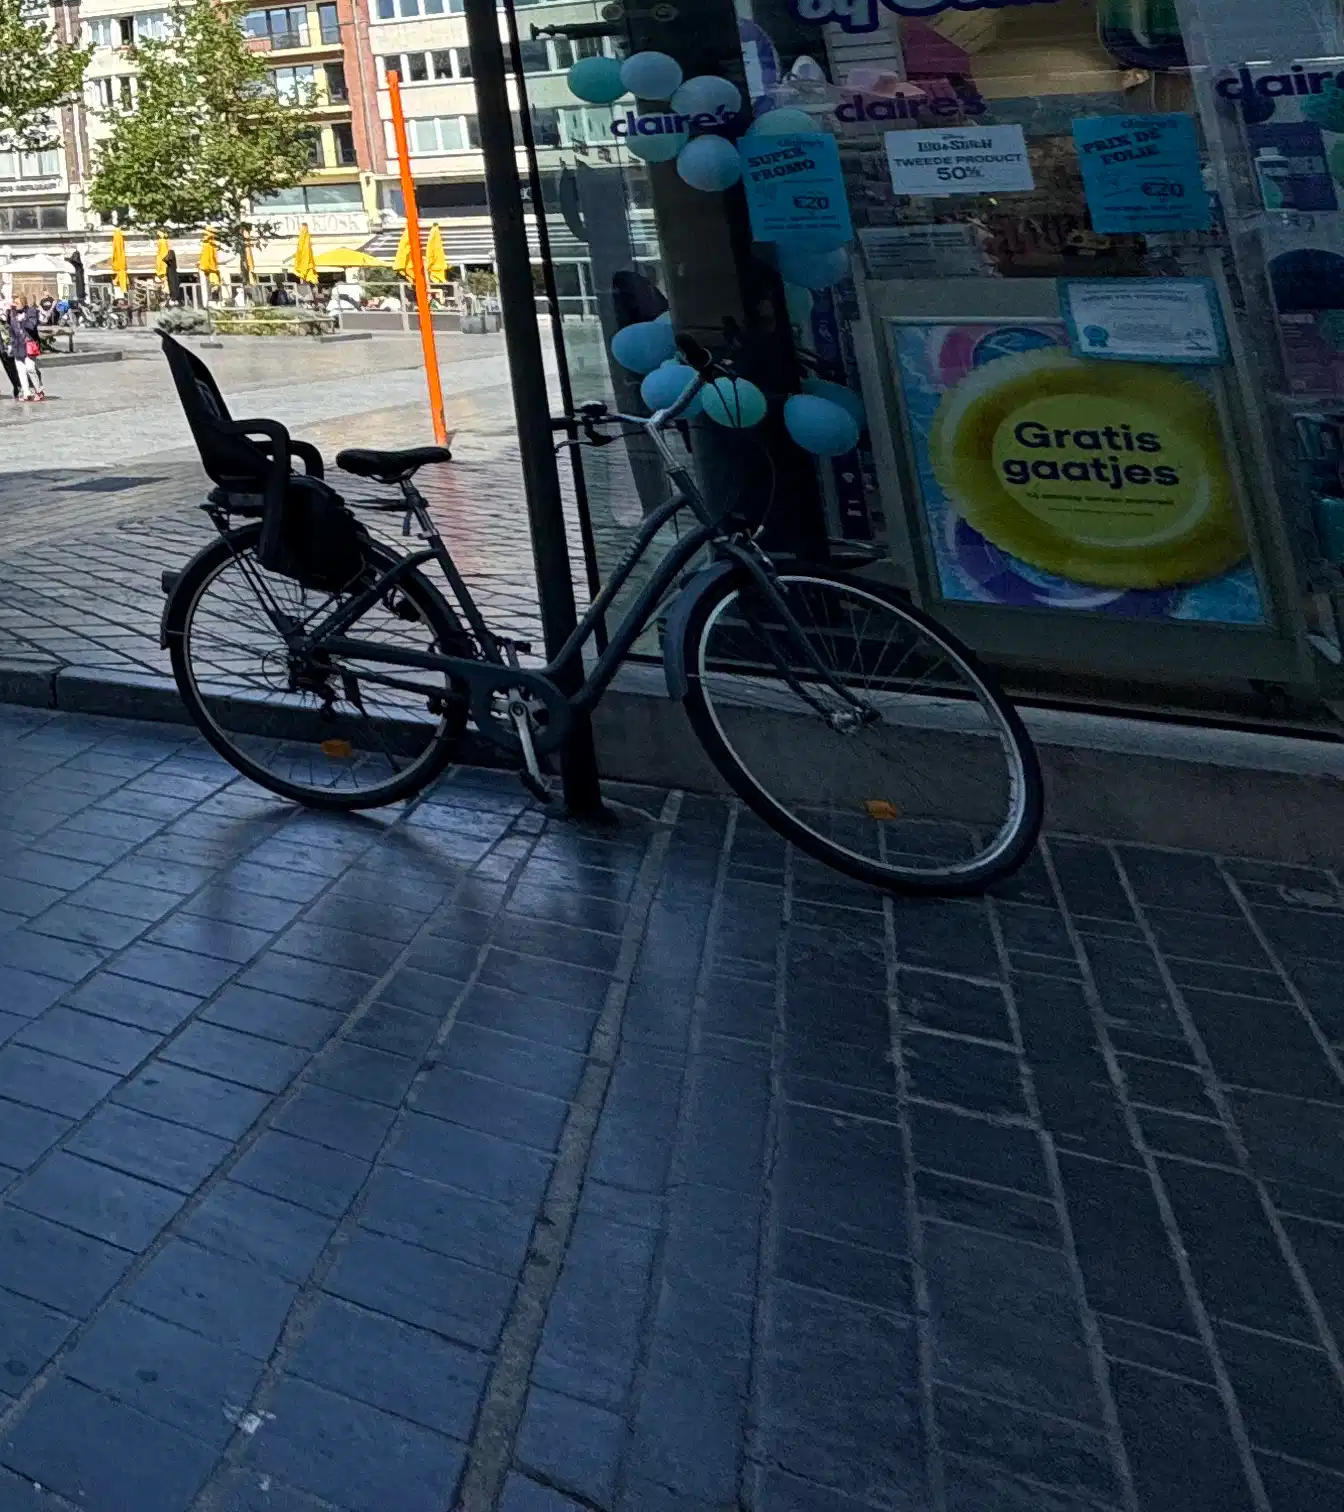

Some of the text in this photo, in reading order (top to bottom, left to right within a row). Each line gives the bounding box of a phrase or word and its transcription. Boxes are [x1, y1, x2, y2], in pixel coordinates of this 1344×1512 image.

[894, 153, 1023, 167] TWEEDE PRODUCT
[937, 165, 985, 181] 50%
[1014, 421, 1162, 454] Gratis
[1002, 455, 1181, 490] gaatjes
